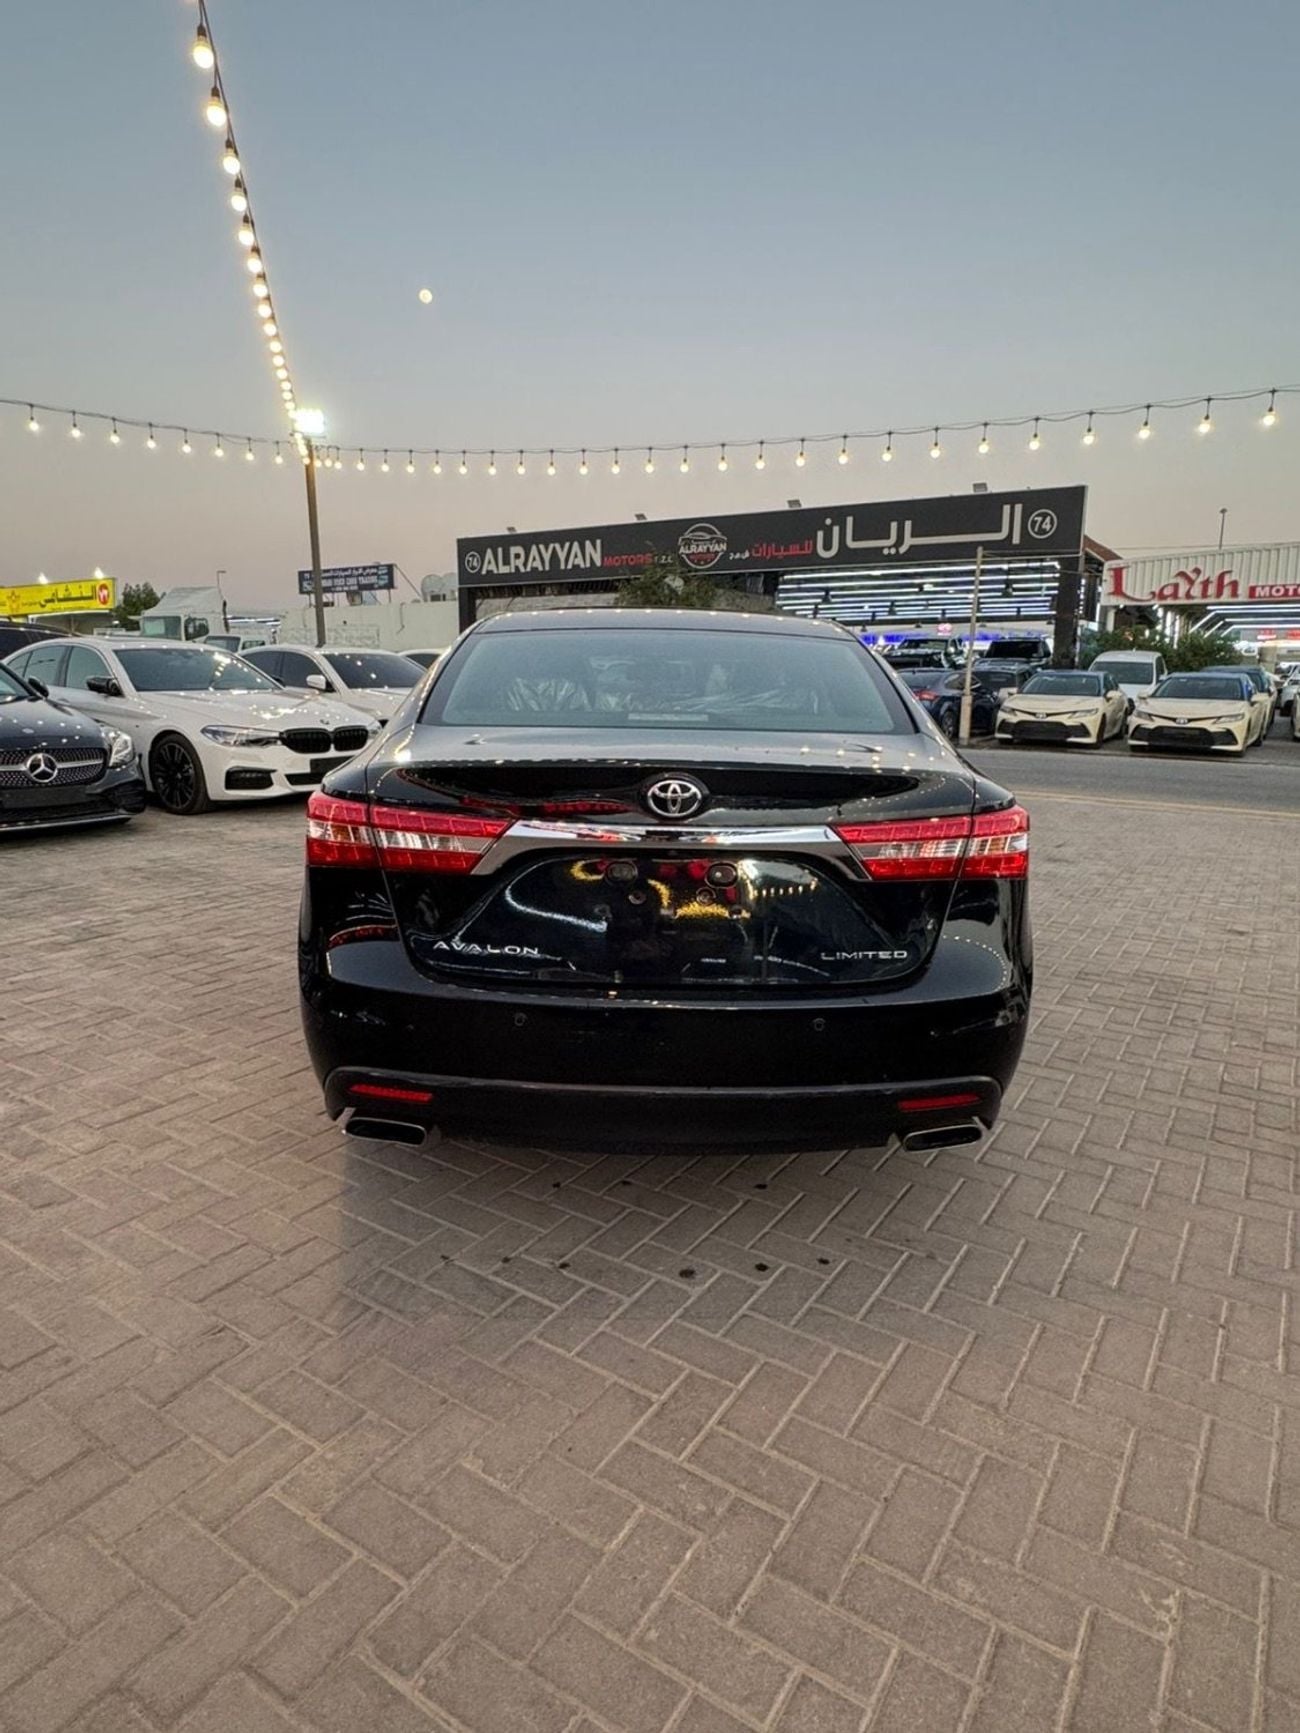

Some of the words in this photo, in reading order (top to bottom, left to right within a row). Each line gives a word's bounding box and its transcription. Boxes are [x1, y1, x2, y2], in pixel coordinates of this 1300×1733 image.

[816, 503, 1023, 559] الريان
[1032, 515, 1053, 534] 74
[481, 538, 602, 575] ALRAYYAN
[602, 552, 653, 568] MOTORS
[679, 542, 727, 555] ALRAYYAN
[1255, 585, 1300, 598] MOT
[432, 939, 539, 956] AVALON
[820, 950, 908, 961] LIMITED
